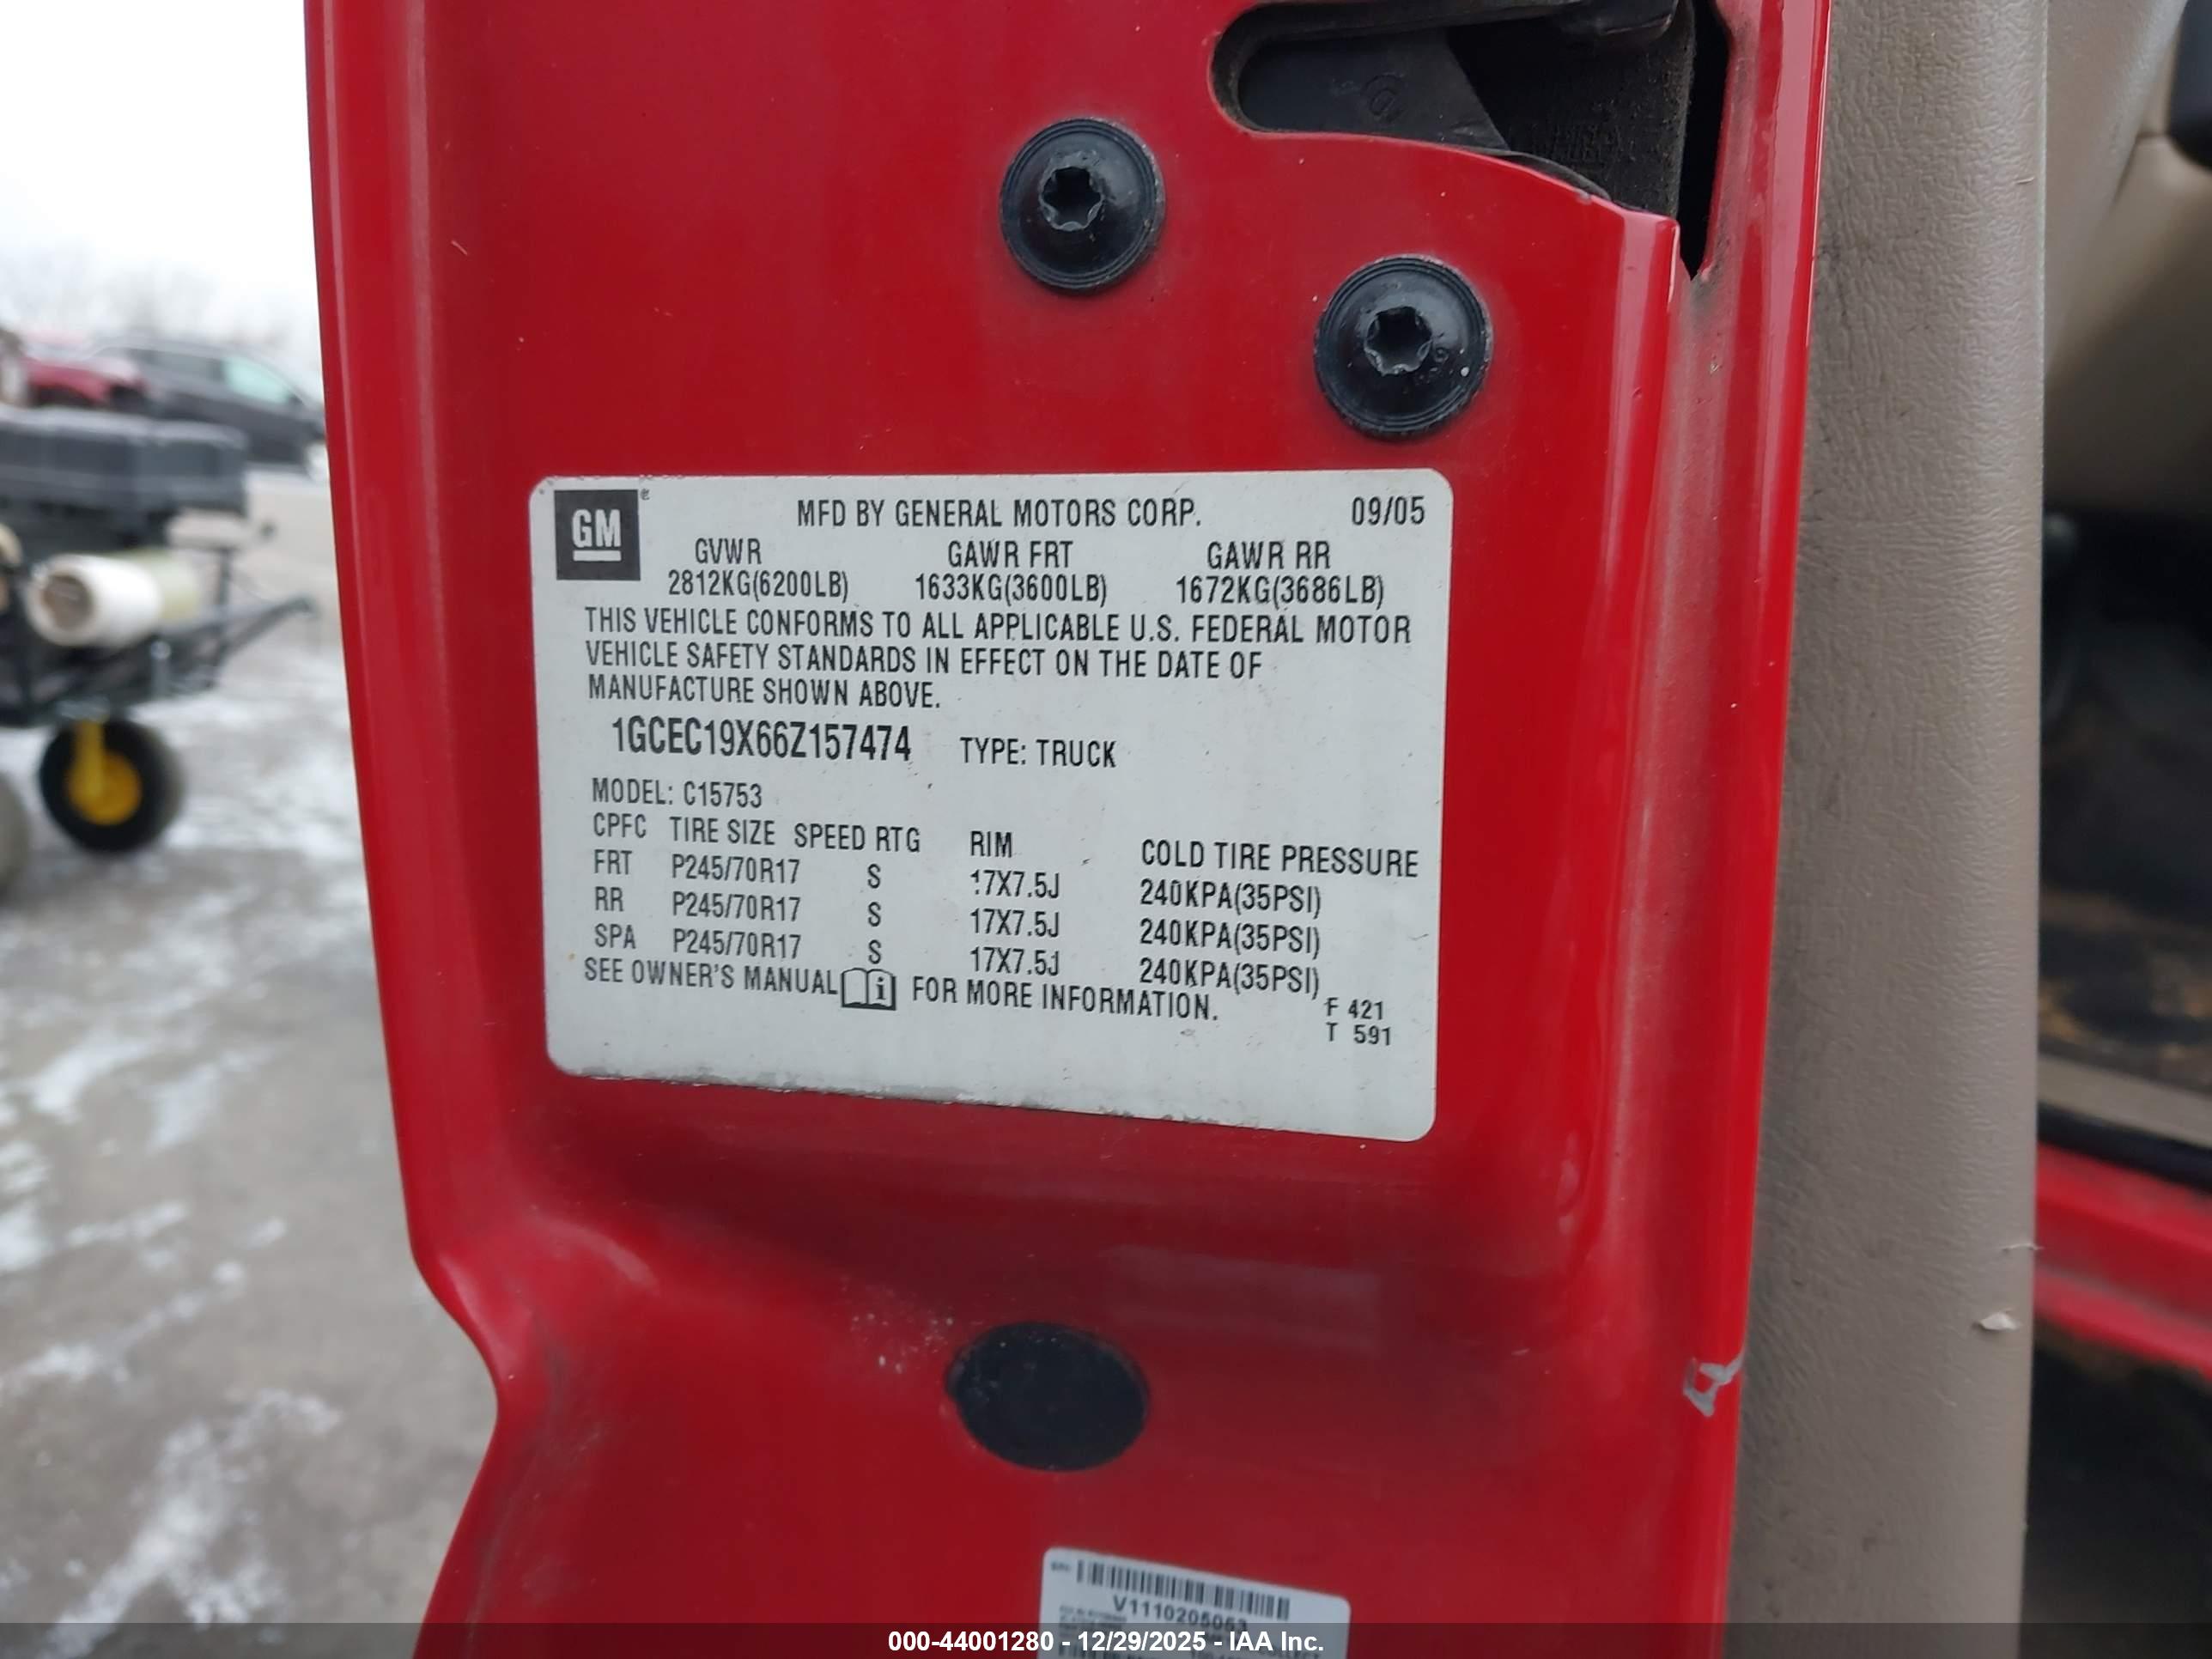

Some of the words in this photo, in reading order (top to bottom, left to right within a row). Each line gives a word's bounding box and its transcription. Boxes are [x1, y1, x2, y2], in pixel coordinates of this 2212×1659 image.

[798, 500, 845, 526] MFD
[857, 500, 884, 526] BY
[896, 500, 1002, 526] GENERAL
[1014, 499, 1115, 526] MOTORS
[1128, 498, 1200, 526] CORP.
[1352, 495, 1425, 526] 09/05
[573, 509, 621, 547] GM
[696, 538, 762, 564] GVWR
[949, 541, 1019, 568] GAWR
[1030, 541, 1073, 568] FRT
[1207, 541, 1284, 569] GAWR
[1296, 541, 1330, 569] RR
[669, 569, 848, 603] 2812KG(6200LB)
[916, 574, 1106, 607] 1633KG(3600LB)
[1176, 575, 1383, 611] 1672KG(3686LB)
[585, 607, 635, 632] THIS
[644, 608, 736, 635] VEHICLE
[747, 609, 872, 637] CONFORMS
[882, 611, 910, 637] TO
[922, 612, 963, 639] ALL
[975, 613, 1119, 641] APPLICABLE
[1131, 614, 1179, 641] U.S.
[1193, 615, 1304, 642] FEDERAL
[1316, 615, 1410, 643] MOTOR
[586, 641, 678, 667] VEHICLE
[687, 642, 769, 669] SAFETY
[778, 644, 915, 672] STANDARDS
[927, 647, 948, 673] IN
[962, 647, 1045, 675] EFFECT
[1056, 649, 1088, 676] ON
[1099, 650, 1146, 677] THE
[1158, 651, 1219, 678] DATE
[1231, 652, 1261, 678] OF
[589, 674, 753, 702] MANUFACTURE
[763, 678, 848, 706] SHOWN
[859, 680, 939, 708] ABOVE.
[612, 715, 911, 761] 1GCEC19X66Z157474
[960, 737, 1025, 764] TYPE:
[1036, 739, 1116, 768] TRUCK
[592, 778, 672, 805] MODEL:
[684, 781, 762, 808] C15753
[594, 812, 646, 838] CPFC
[670, 817, 718, 842] TIRE
[727, 819, 775, 845] SIZE
[794, 823, 865, 850] SPEED
[877, 826, 920, 852] RTG
[970, 831, 1012, 858] RIM
[1142, 839, 1204, 867] COLD
[1214, 842, 1270, 871] TIRE
[1282, 845, 1418, 878] PRESSURE
[594, 849, 632, 874] FRT
[672, 854, 799, 884] P245/70R17
[868, 864, 880, 889] S
[595, 886, 623, 911] RR
[971, 870, 1059, 898] 17X7.5J
[673, 891, 800, 921] P245/70R17
[868, 902, 881, 927] S
[1140, 878, 1321, 922] 240KPA(35PSI)
[595, 923, 635, 949] SPA
[970, 908, 1059, 938] 17X7.5J
[673, 928, 800, 958] P245/70R17
[868, 939, 881, 964] S
[1140, 918, 1319, 959] 240KPA(35PSI)
[585, 957, 623, 982] SEE
[632, 960, 733, 988] OWNER'S
[744, 966, 838, 994] MANUAL
[970, 947, 1059, 976] 17X7.5J
[1140, 957, 1319, 999] 240KPA(35PSI)
[914, 976, 957, 1003] FOR
[968, 979, 1031, 1008] MORE
[1043, 984, 1218, 1020] INFORMATION.
[1323, 997, 1339, 1016] F
[1348, 1000, 1382, 1020] 421
[1326, 1022, 1339, 1042] T
[1354, 1024, 1390, 1046] 591
